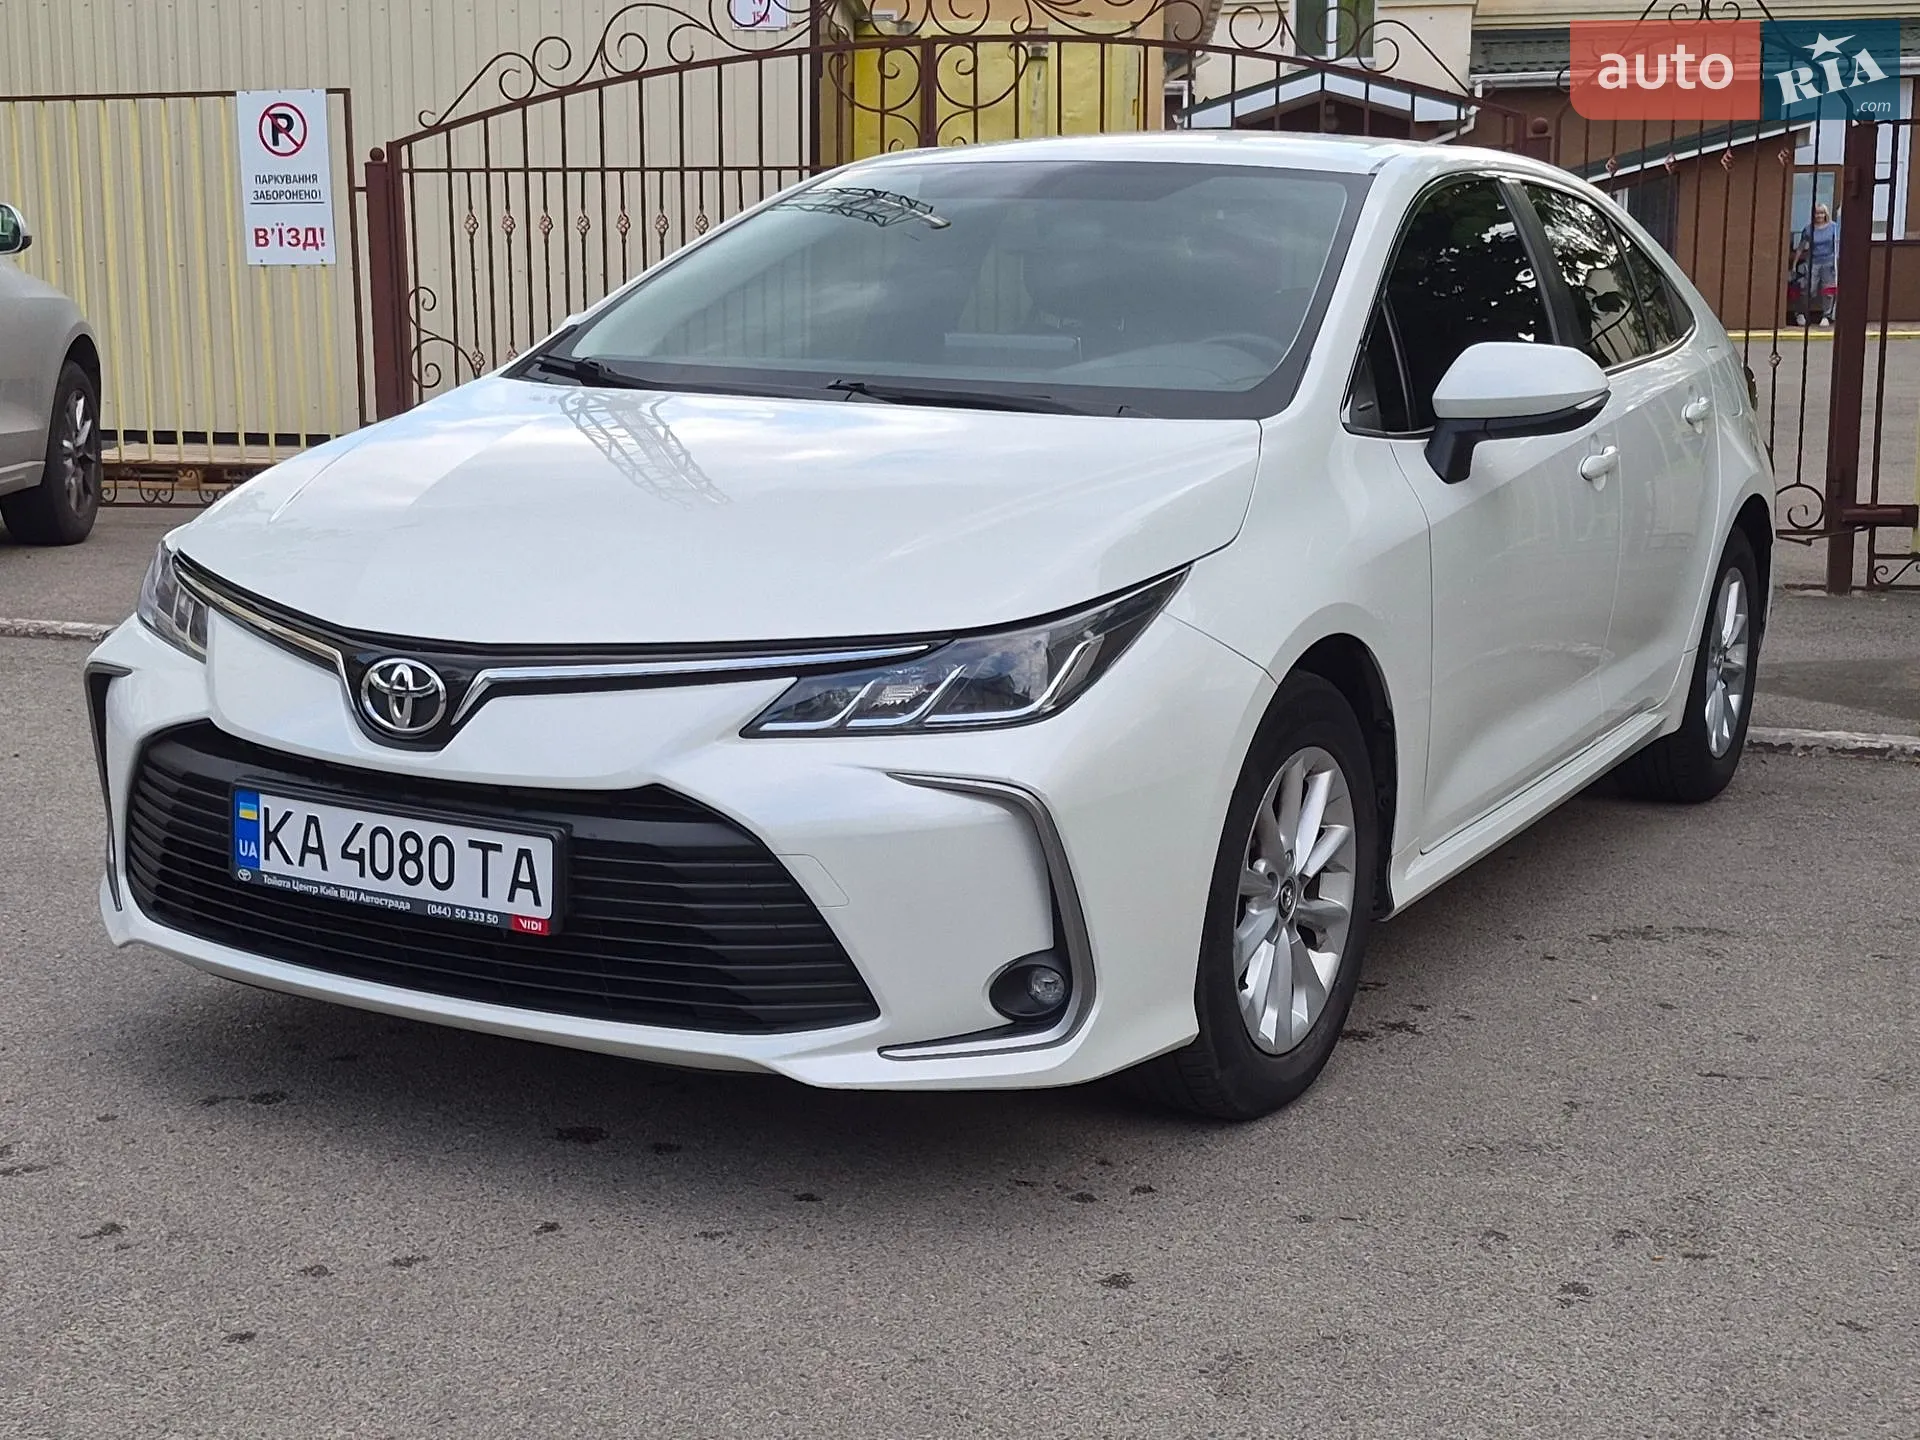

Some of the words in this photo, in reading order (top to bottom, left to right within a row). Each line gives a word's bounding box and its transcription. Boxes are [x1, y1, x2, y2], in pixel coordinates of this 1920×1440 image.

[254, 173, 319, 186] ПАРКУВАННЯ
[252, 189, 322, 201] ЗАБОРОНЕНО!
[238, 838, 258, 859] UA
[340, 821, 456, 892] 4080
[262, 874, 291, 888] Тойота
[292, 880, 319, 895] Центр
[319, 885, 339, 898] Київ
[358, 892, 411, 912] Автострада
[427, 903, 452, 918] (044)
[454, 908, 467, 919] 50
[467, 911, 485, 923] 333
[486, 914, 499, 925] 50
[518, 918, 542, 932] VIDI
